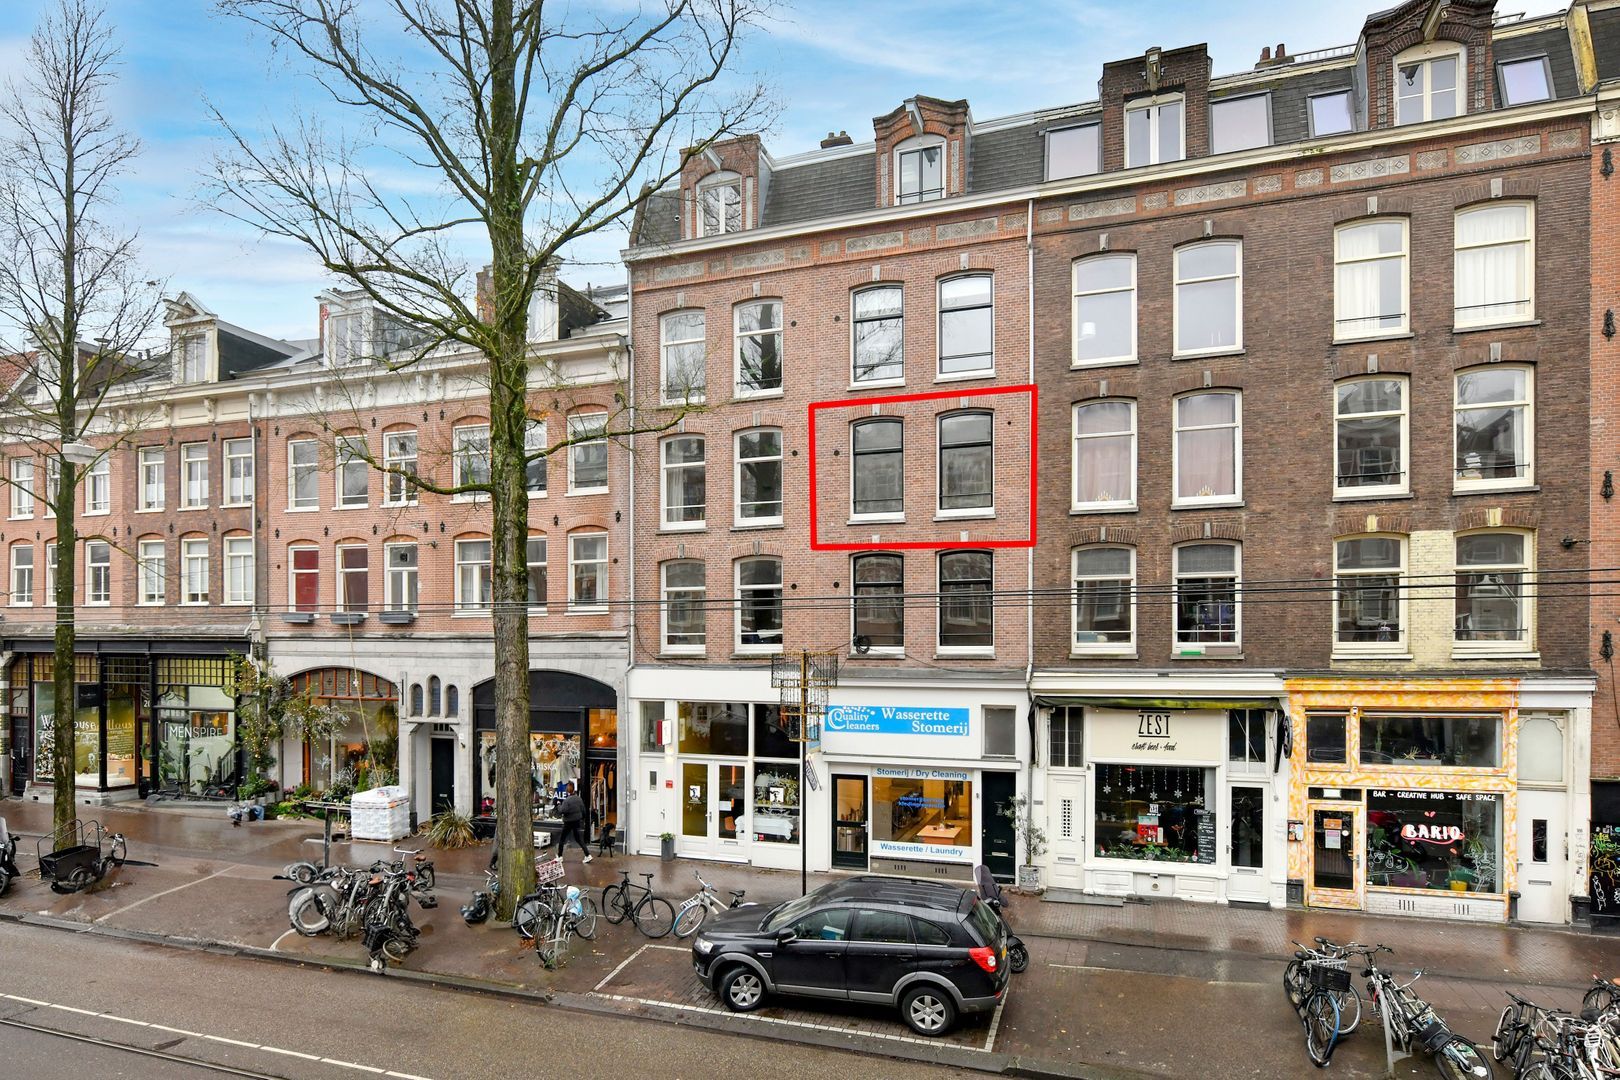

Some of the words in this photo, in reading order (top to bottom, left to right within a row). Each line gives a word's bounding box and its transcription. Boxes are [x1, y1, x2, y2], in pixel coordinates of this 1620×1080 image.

[834, 710, 869, 722] Quality
[881, 707, 950, 720] Wasserette
[912, 721, 968, 735] Stomerij
[1138, 714, 1170, 735] ZEST
[169, 726, 223, 738] MENSPIRE
[876, 768, 909, 777] Stomerij
[916, 769, 930, 778] Dry
[931, 770, 968, 780] Cleaning
[548, 791, 567, 800] SALE
[1397, 792, 1427, 800] CREATIVE
[1405, 824, 1461, 840] BARIO
[880, 843, 924, 853] Wasserette
[930, 846, 963, 857] Laundry
